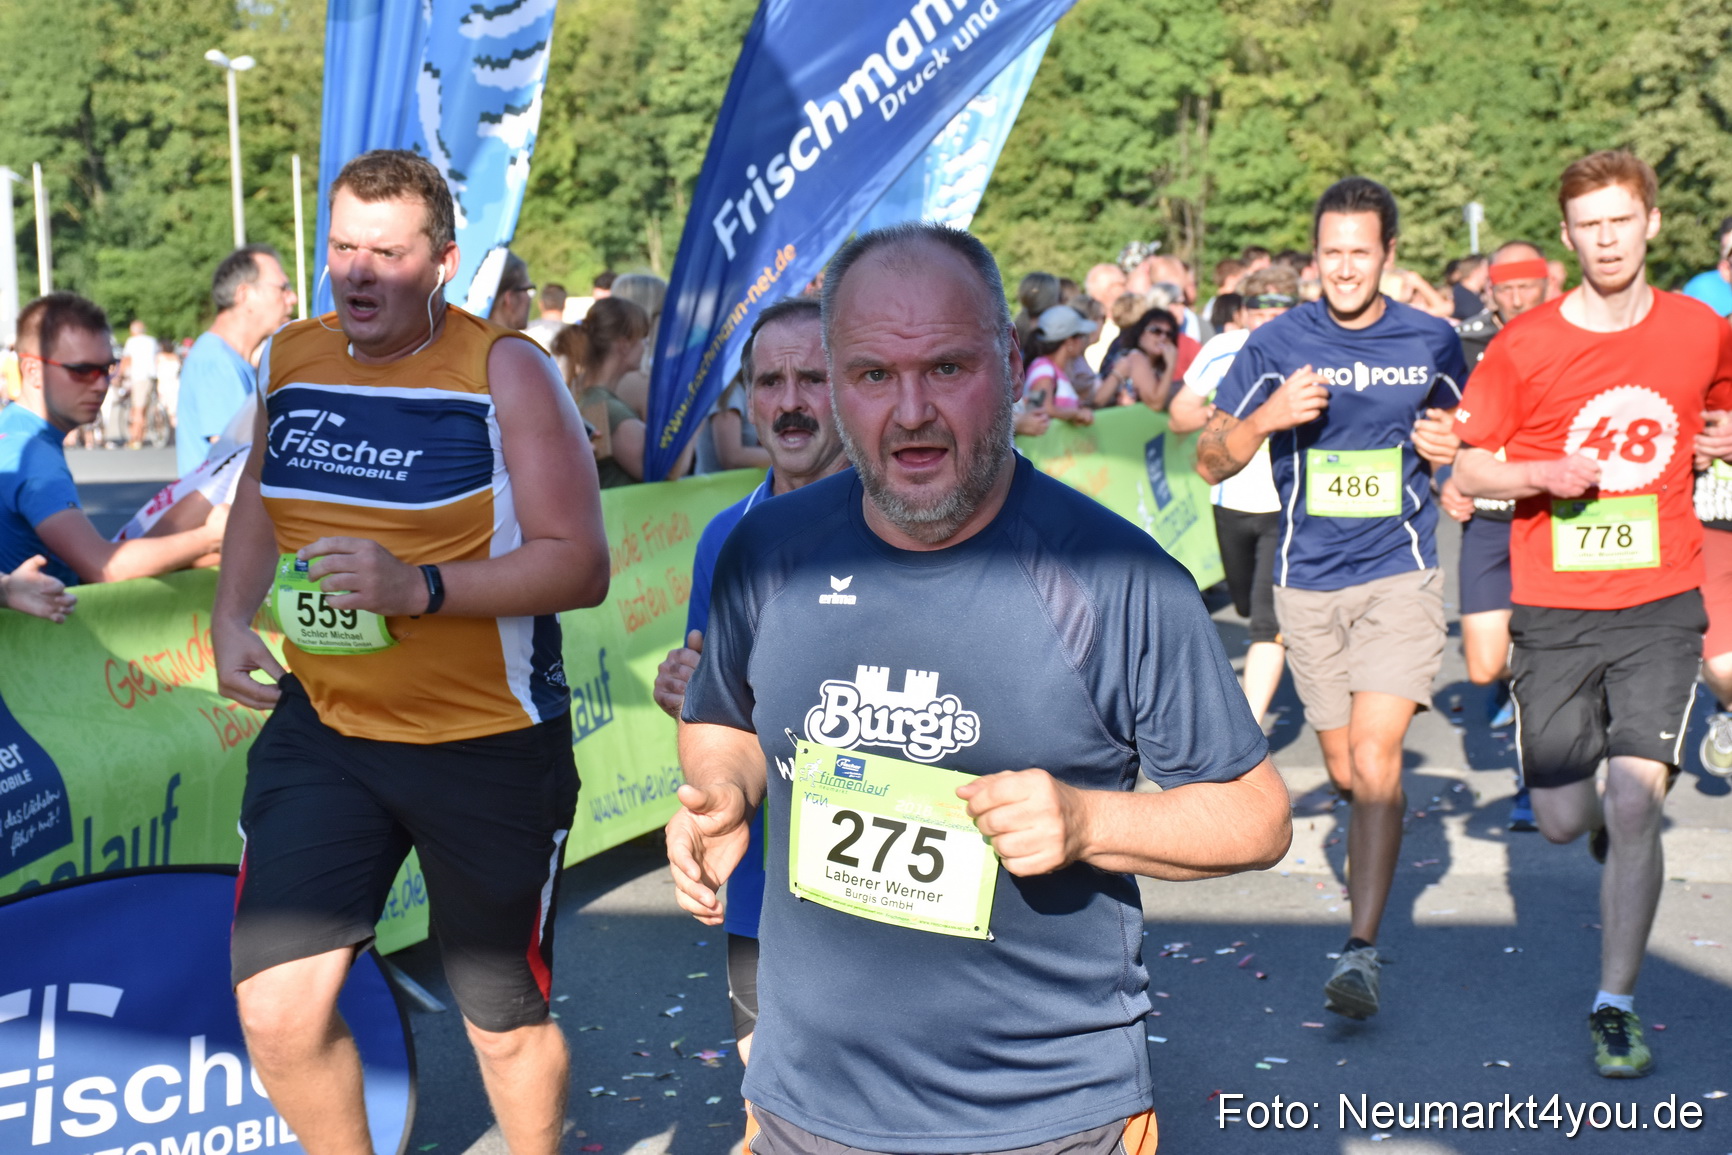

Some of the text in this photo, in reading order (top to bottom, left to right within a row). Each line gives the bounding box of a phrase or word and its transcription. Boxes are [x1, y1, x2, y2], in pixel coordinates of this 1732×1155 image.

[878, 47, 951, 122] Druck
[712, 0, 968, 262] Frischman
[1317, 366, 1429, 387] RO POLES
[280, 428, 424, 468] Fischer
[1579, 416, 1663, 464] 48
[286, 456, 409, 481] AUTOMOBILE
[1327, 475, 1380, 498] 486
[1575, 524, 1633, 550] 778
[296, 591, 358, 630] 559
[818, 592, 857, 605] erima
[300, 628, 364, 641] Schlor Michael
[319, 638, 352, 648] Automobile
[804, 680, 980, 763] Burgis
[0, 743, 24, 773] er
[0, 768, 33, 796] OBILE
[819, 771, 891, 798] firmenlauf
[894, 799, 934, 817] 2018
[827, 809, 947, 884] 275
[825, 865, 881, 892] Laberer
[885, 880, 943, 904] Werner
[845, 887, 878, 904] Burgis
[880, 895, 914, 911] GmbH
